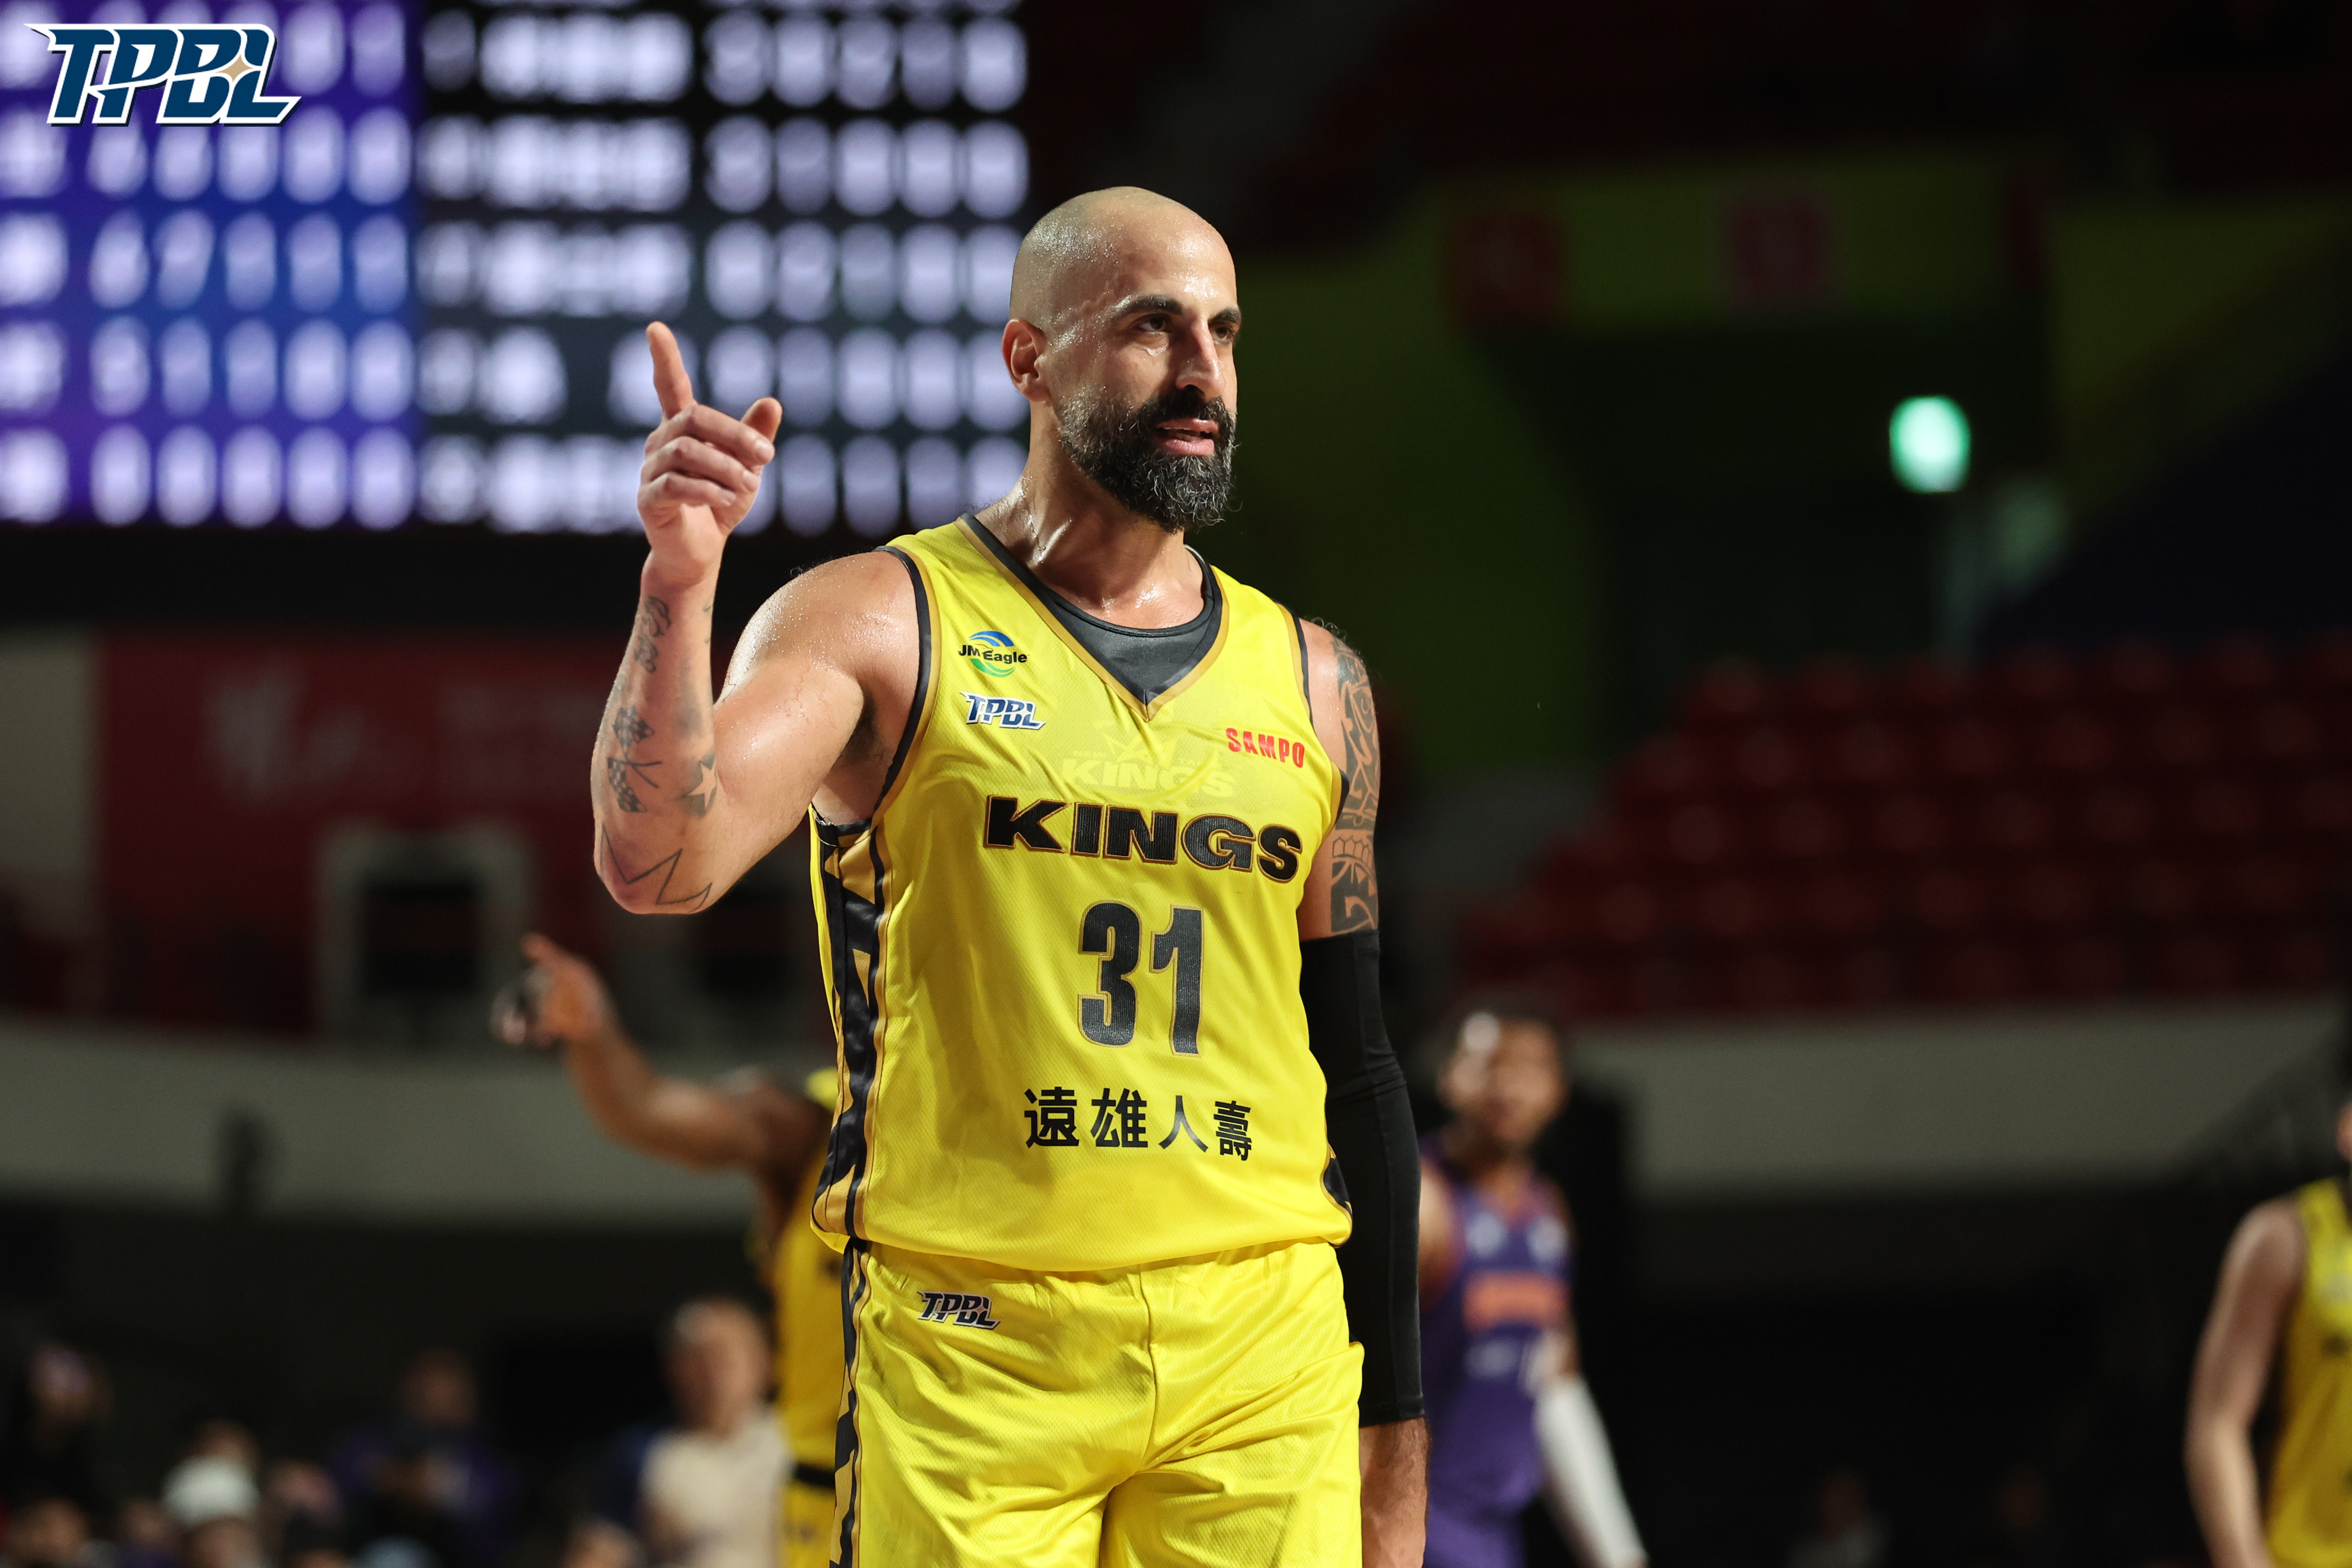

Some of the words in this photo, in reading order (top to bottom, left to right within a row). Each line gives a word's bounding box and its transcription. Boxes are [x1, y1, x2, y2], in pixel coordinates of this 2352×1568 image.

[959, 691, 1046, 730] TPBL
[1226, 728, 1304, 768] SAMPO
[984, 795, 1303, 883] KINGS
[1078, 899, 1203, 1057] 31
[1024, 1086, 1252, 1161] 遠雄人壽
[917, 1291, 1001, 1330] TPBL
